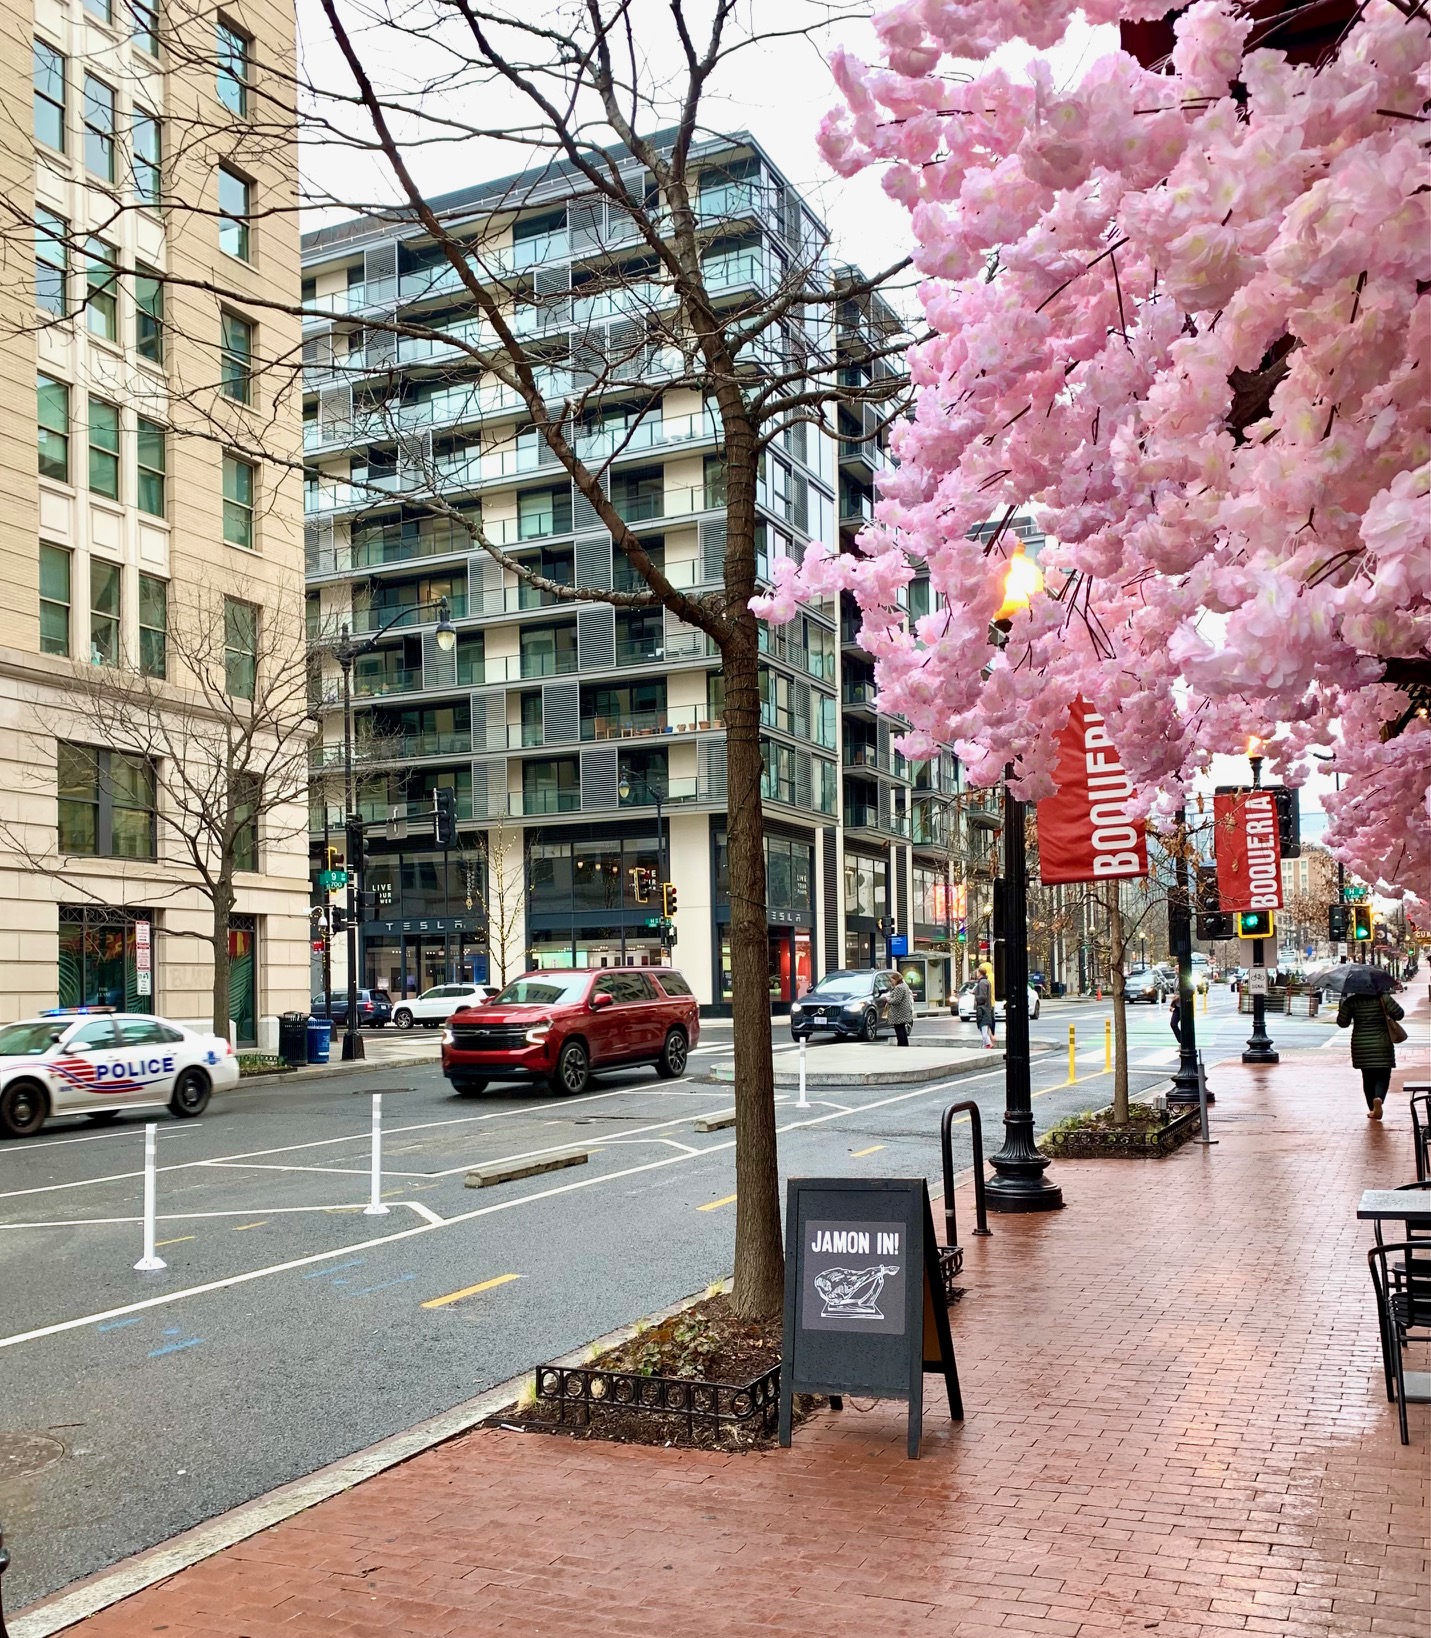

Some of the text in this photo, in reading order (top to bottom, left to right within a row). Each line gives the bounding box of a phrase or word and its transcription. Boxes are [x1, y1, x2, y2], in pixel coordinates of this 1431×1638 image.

[1245, 795, 1279, 909] BOQUERIA
[331, 872, 337, 881] 9
[771, 911, 801, 922] ESLA
[385, 920, 463, 931] TESLA
[96, 1057, 174, 1081] POLICE
[811, 1231, 899, 1255] JAMON IN!
